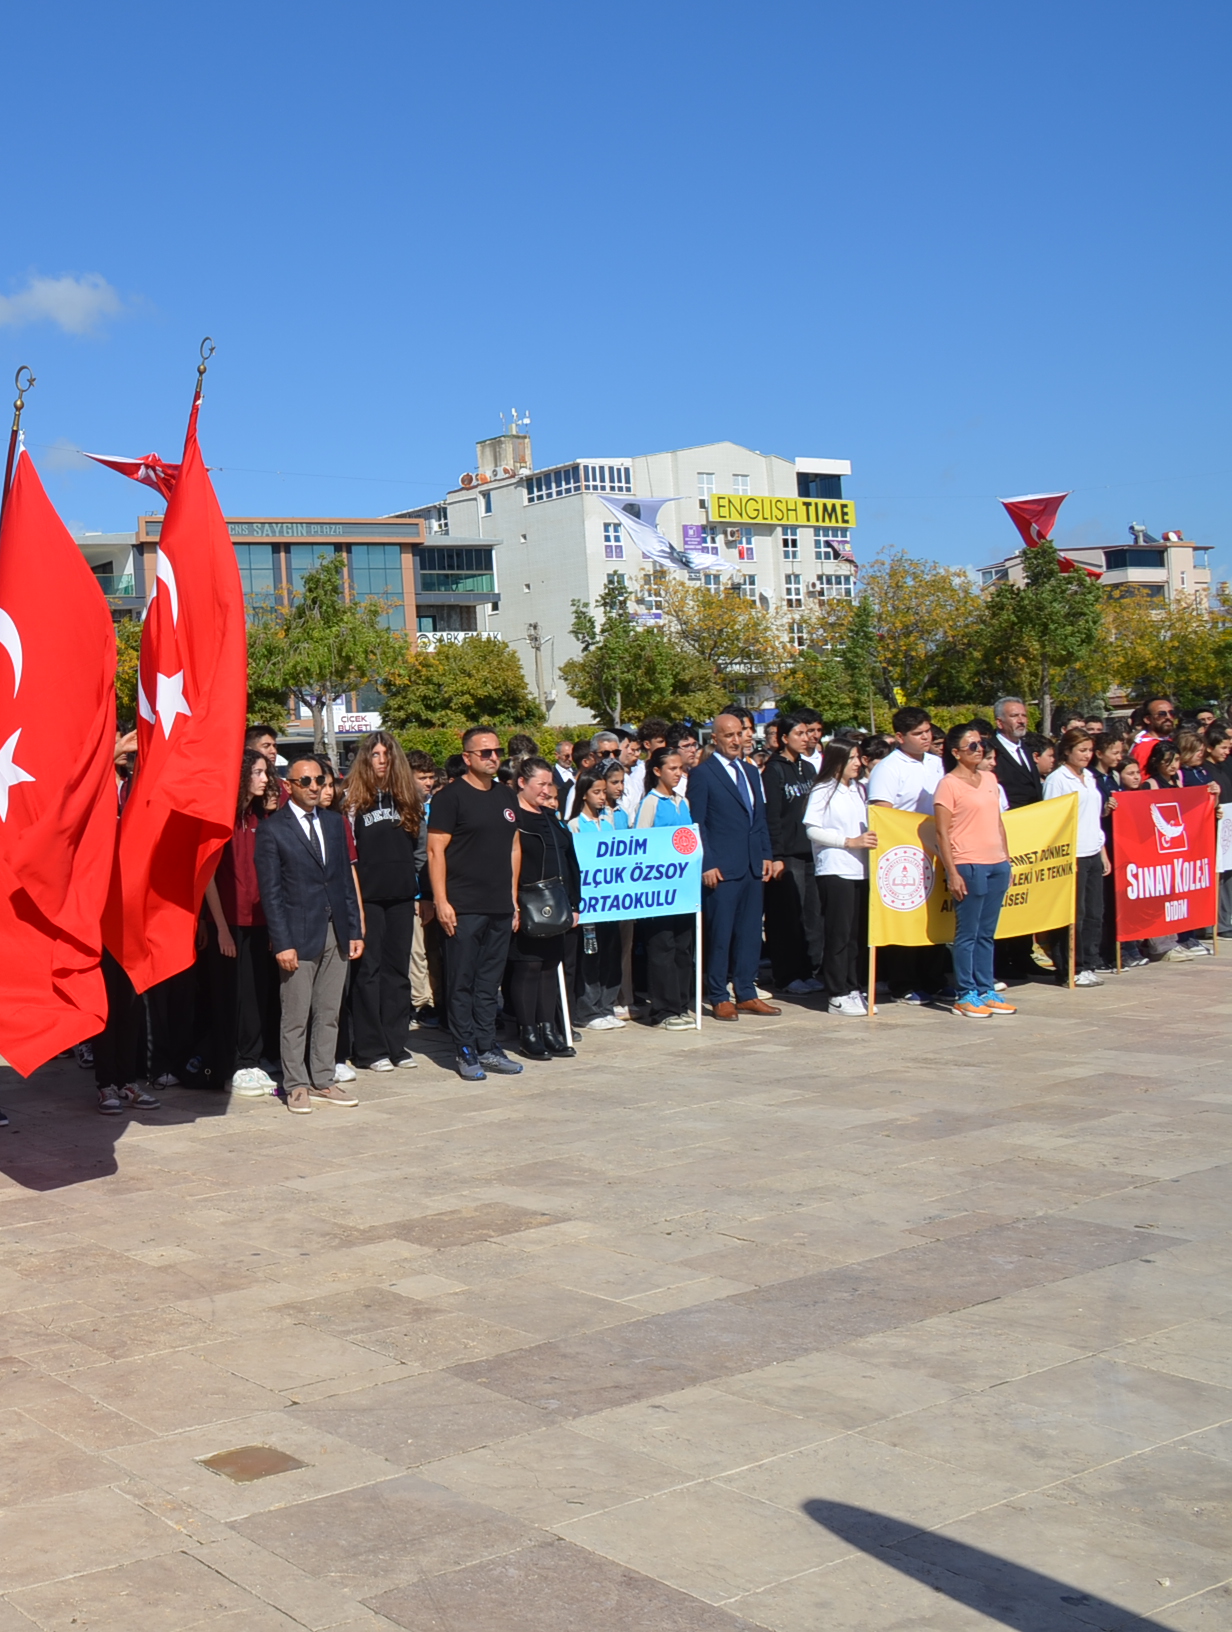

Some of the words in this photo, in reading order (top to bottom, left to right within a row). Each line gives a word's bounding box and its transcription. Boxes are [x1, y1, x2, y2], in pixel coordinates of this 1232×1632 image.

[717, 496, 798, 522] ENGLISH
[802, 501, 850, 524] TIME
[253, 523, 307, 537] SAYGIN
[311, 525, 343, 535] PLAZA
[596, 835, 648, 858] DİDİM
[1040, 843, 1070, 862] DÖNMEZ
[580, 866, 627, 888] LÇUK
[630, 862, 689, 882] ÖZSOY
[1012, 868, 1033, 886] LEKİ
[1035, 868, 1045, 882] VE
[1047, 860, 1073, 880] TEKNİK
[1126, 863, 1172, 900] SINAV
[578, 889, 677, 914] ORTAOKULU
[1001, 888, 1029, 908] İSESİ
